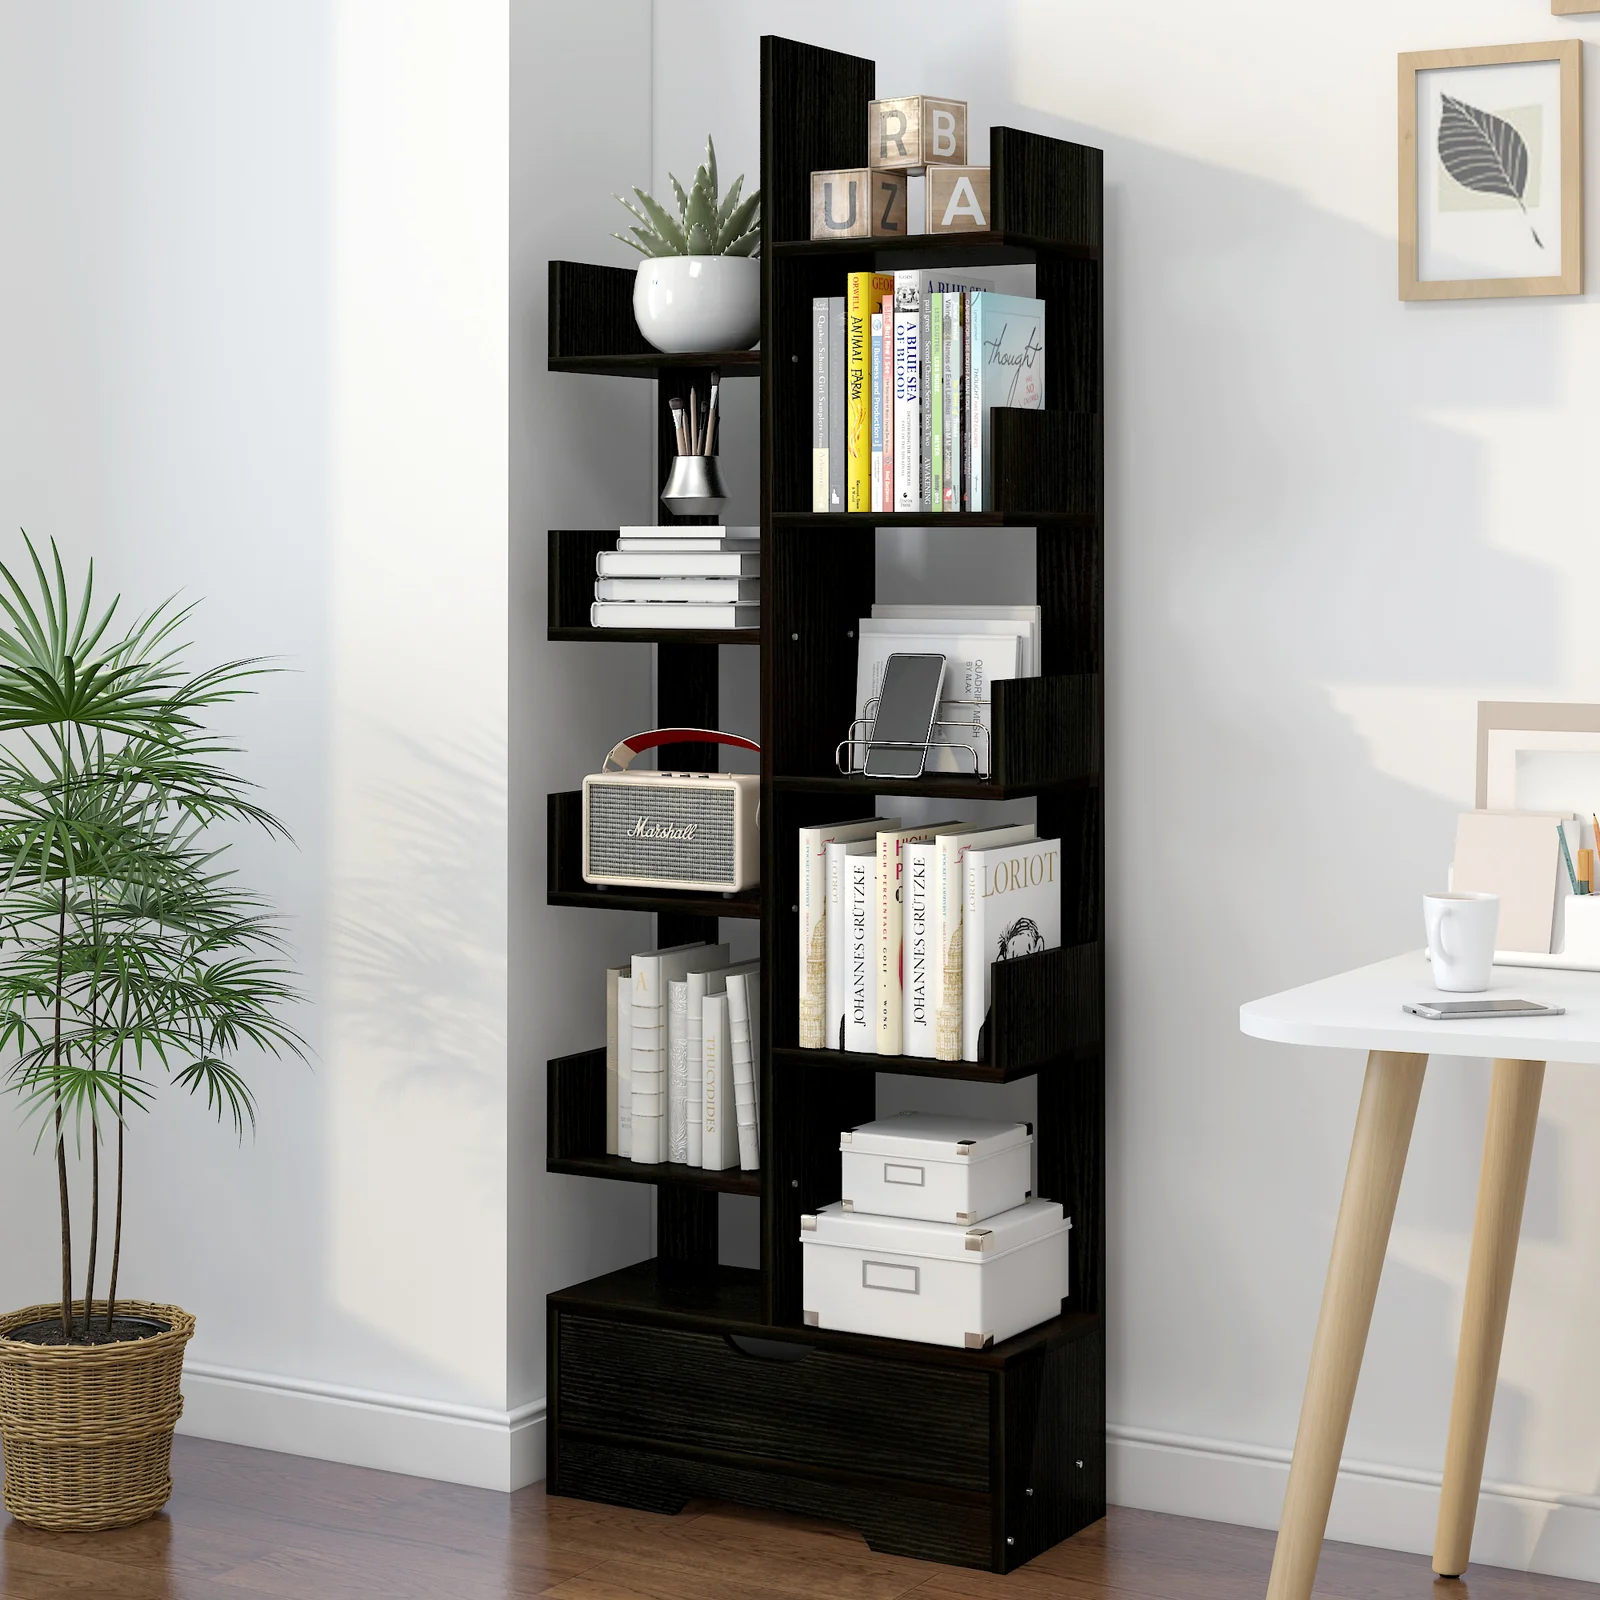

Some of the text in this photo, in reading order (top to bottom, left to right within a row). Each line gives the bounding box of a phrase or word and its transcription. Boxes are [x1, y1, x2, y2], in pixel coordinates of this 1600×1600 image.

[880, 108, 908, 159] R
[932, 110, 957, 157] B
[824, 180, 857, 231] U
[880, 182, 898, 232] Z
[940, 176, 987, 226] A
[818, 316, 826, 345] Quaker
[850, 316, 864, 365] ANIMAL
[852, 368, 863, 401] FARM
[896, 326, 905, 400] OF BLOOD
[906, 322, 917, 402] A BLUE SEA
[1026, 384, 1035, 394] NO
[974, 412, 979, 423] NO
[966, 662, 973, 672] BY
[628, 816, 698, 840] Marshall
[982, 852, 1058, 898] LORIOT
[852, 866, 866, 1027] JOHANNES GRÜTZKE
[912, 858, 927, 1027] JOHANNES GRÜTZKE
[636, 972, 648, 991] A
[706, 1036, 716, 1134] THUCYDIDES
